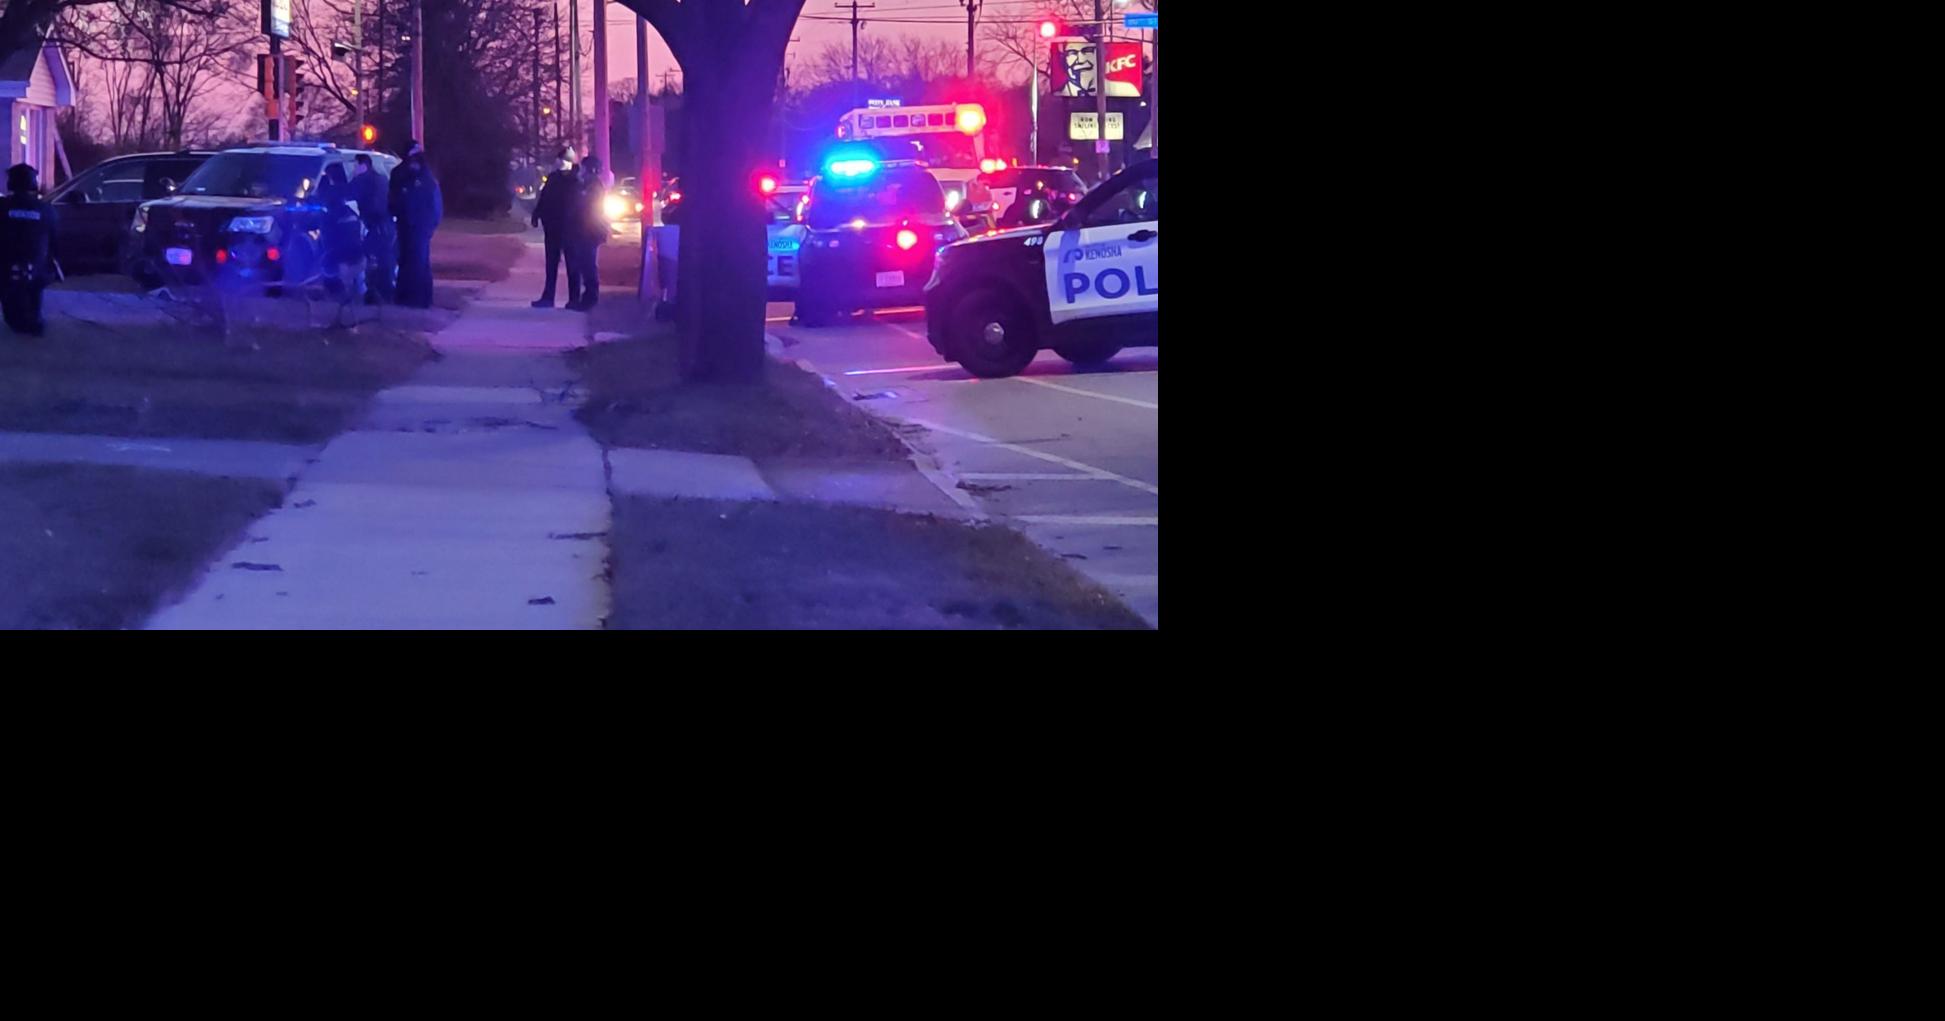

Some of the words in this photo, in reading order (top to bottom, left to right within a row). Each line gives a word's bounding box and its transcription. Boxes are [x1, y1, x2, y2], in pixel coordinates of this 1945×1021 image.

[1106, 54, 1136, 74] KFC
[1085, 246, 1122, 260] KENOSHA
[1063, 265, 1158, 304] POL
